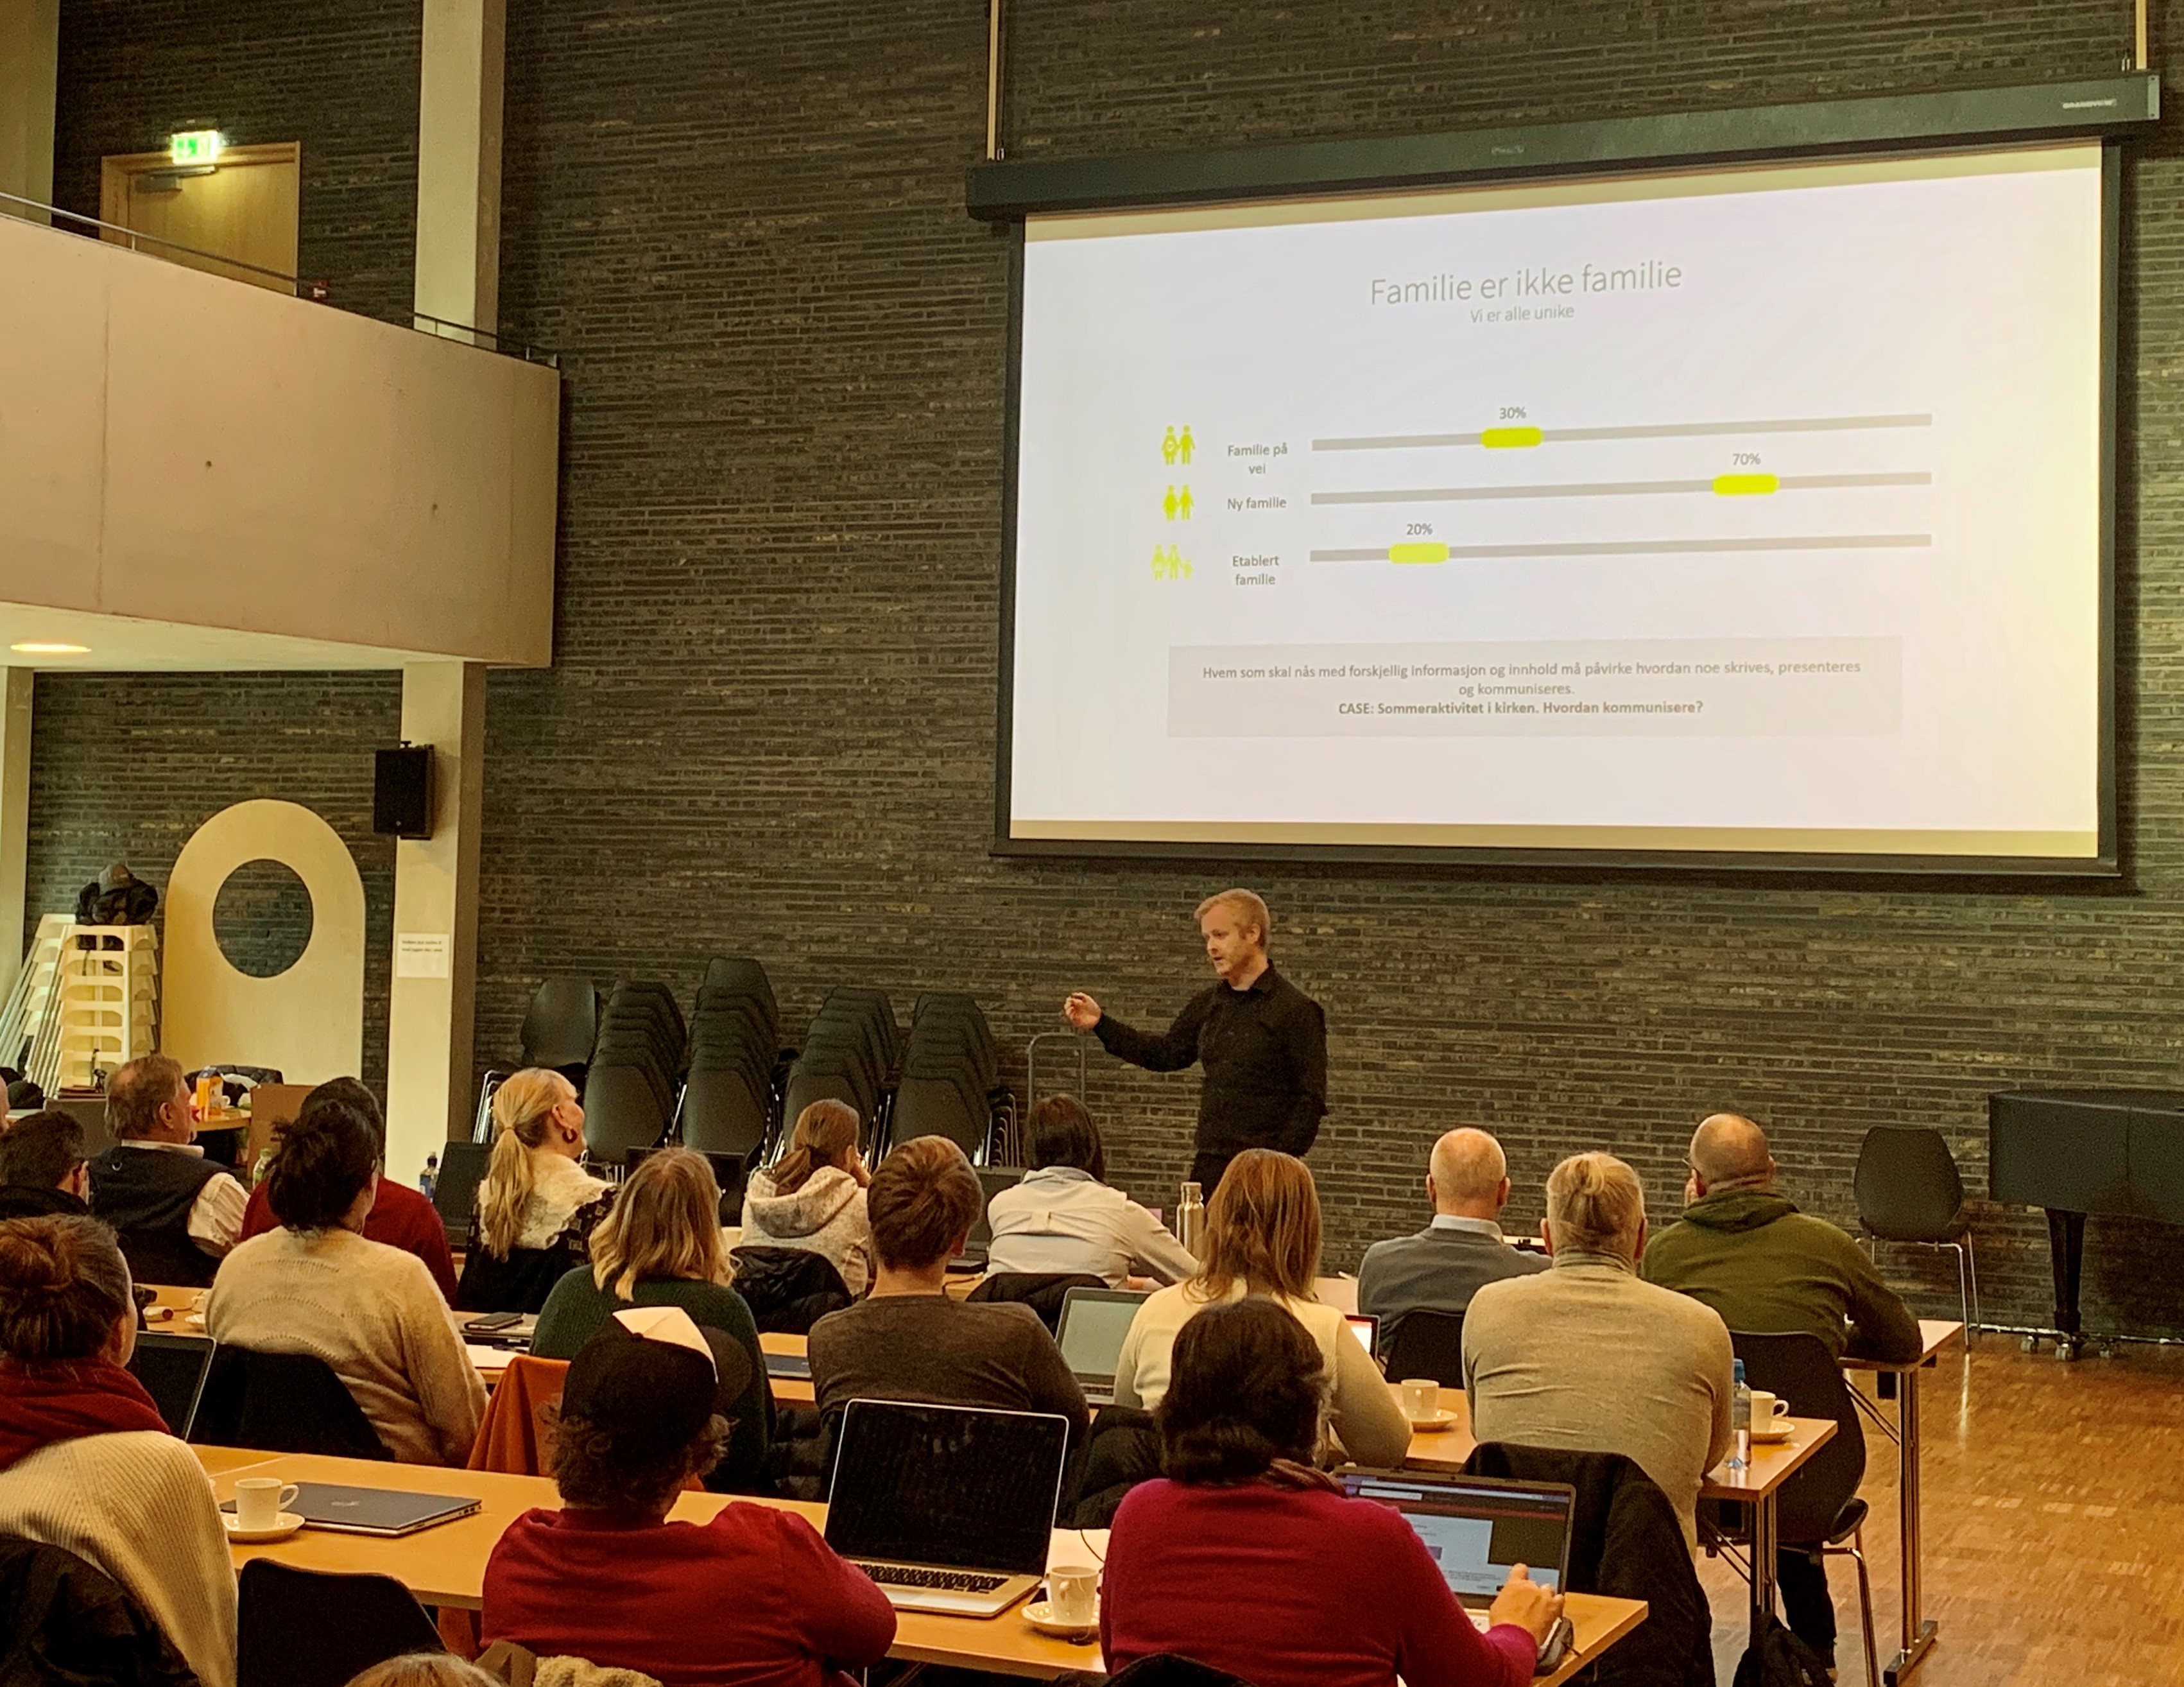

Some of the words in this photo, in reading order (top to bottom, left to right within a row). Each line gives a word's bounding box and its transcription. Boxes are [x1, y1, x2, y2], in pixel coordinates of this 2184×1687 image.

[1371, 273, 1472, 305] Familie
[1480, 277, 1509, 299] er
[1517, 267, 1574, 297] ikke
[1581, 260, 1682, 293] familie
[1470, 309, 1483, 324] Vi
[1486, 311, 1502, 322] er
[1504, 306, 1531, 322] alle
[1534, 304, 1575, 320] unike
[1499, 406, 1527, 420] 30%
[1227, 444, 1269, 456] Familie
[1273, 442, 1288, 458] på
[1732, 453, 1762, 465] 70%
[1248, 462, 1266, 474] vei
[1227, 498, 1243, 512] Ny
[1246, 497, 1287, 509] familie
[1406, 523, 1433, 535] 20%
[1232, 554, 1280, 567] Etablert
[1235, 573, 1276, 585] familie
[1203, 667, 1237, 679] Hvem
[1240, 669, 1266, 679] som
[1268, 666, 1291, 678] skal
[1295, 664, 1316, 677] nås
[1318, 665, 1346, 677] med
[1349, 664, 1408, 680] forskjellig
[1490, 666, 1506, 679] og
[1509, 662, 1558, 675] innhold
[1561, 661, 1581, 675] må
[1585, 661, 1633, 677] påvirke
[1636, 661, 1691, 674] hvordan
[1695, 664, 1721, 674] noe
[1724, 661, 1775, 675] skrives,
[1778, 661, 1861, 676] presenteres
[1459, 686, 1475, 698] og
[1477, 683, 1575, 695] kommuniseres.
[1339, 702, 1374, 714] CASE:
[1377, 702, 1484, 714] Sommeraktivitet
[1495, 701, 1539, 714] kirken.
[1543, 701, 1599, 714] Hvordan
[1603, 700, 1703, 713] kommunisere?
